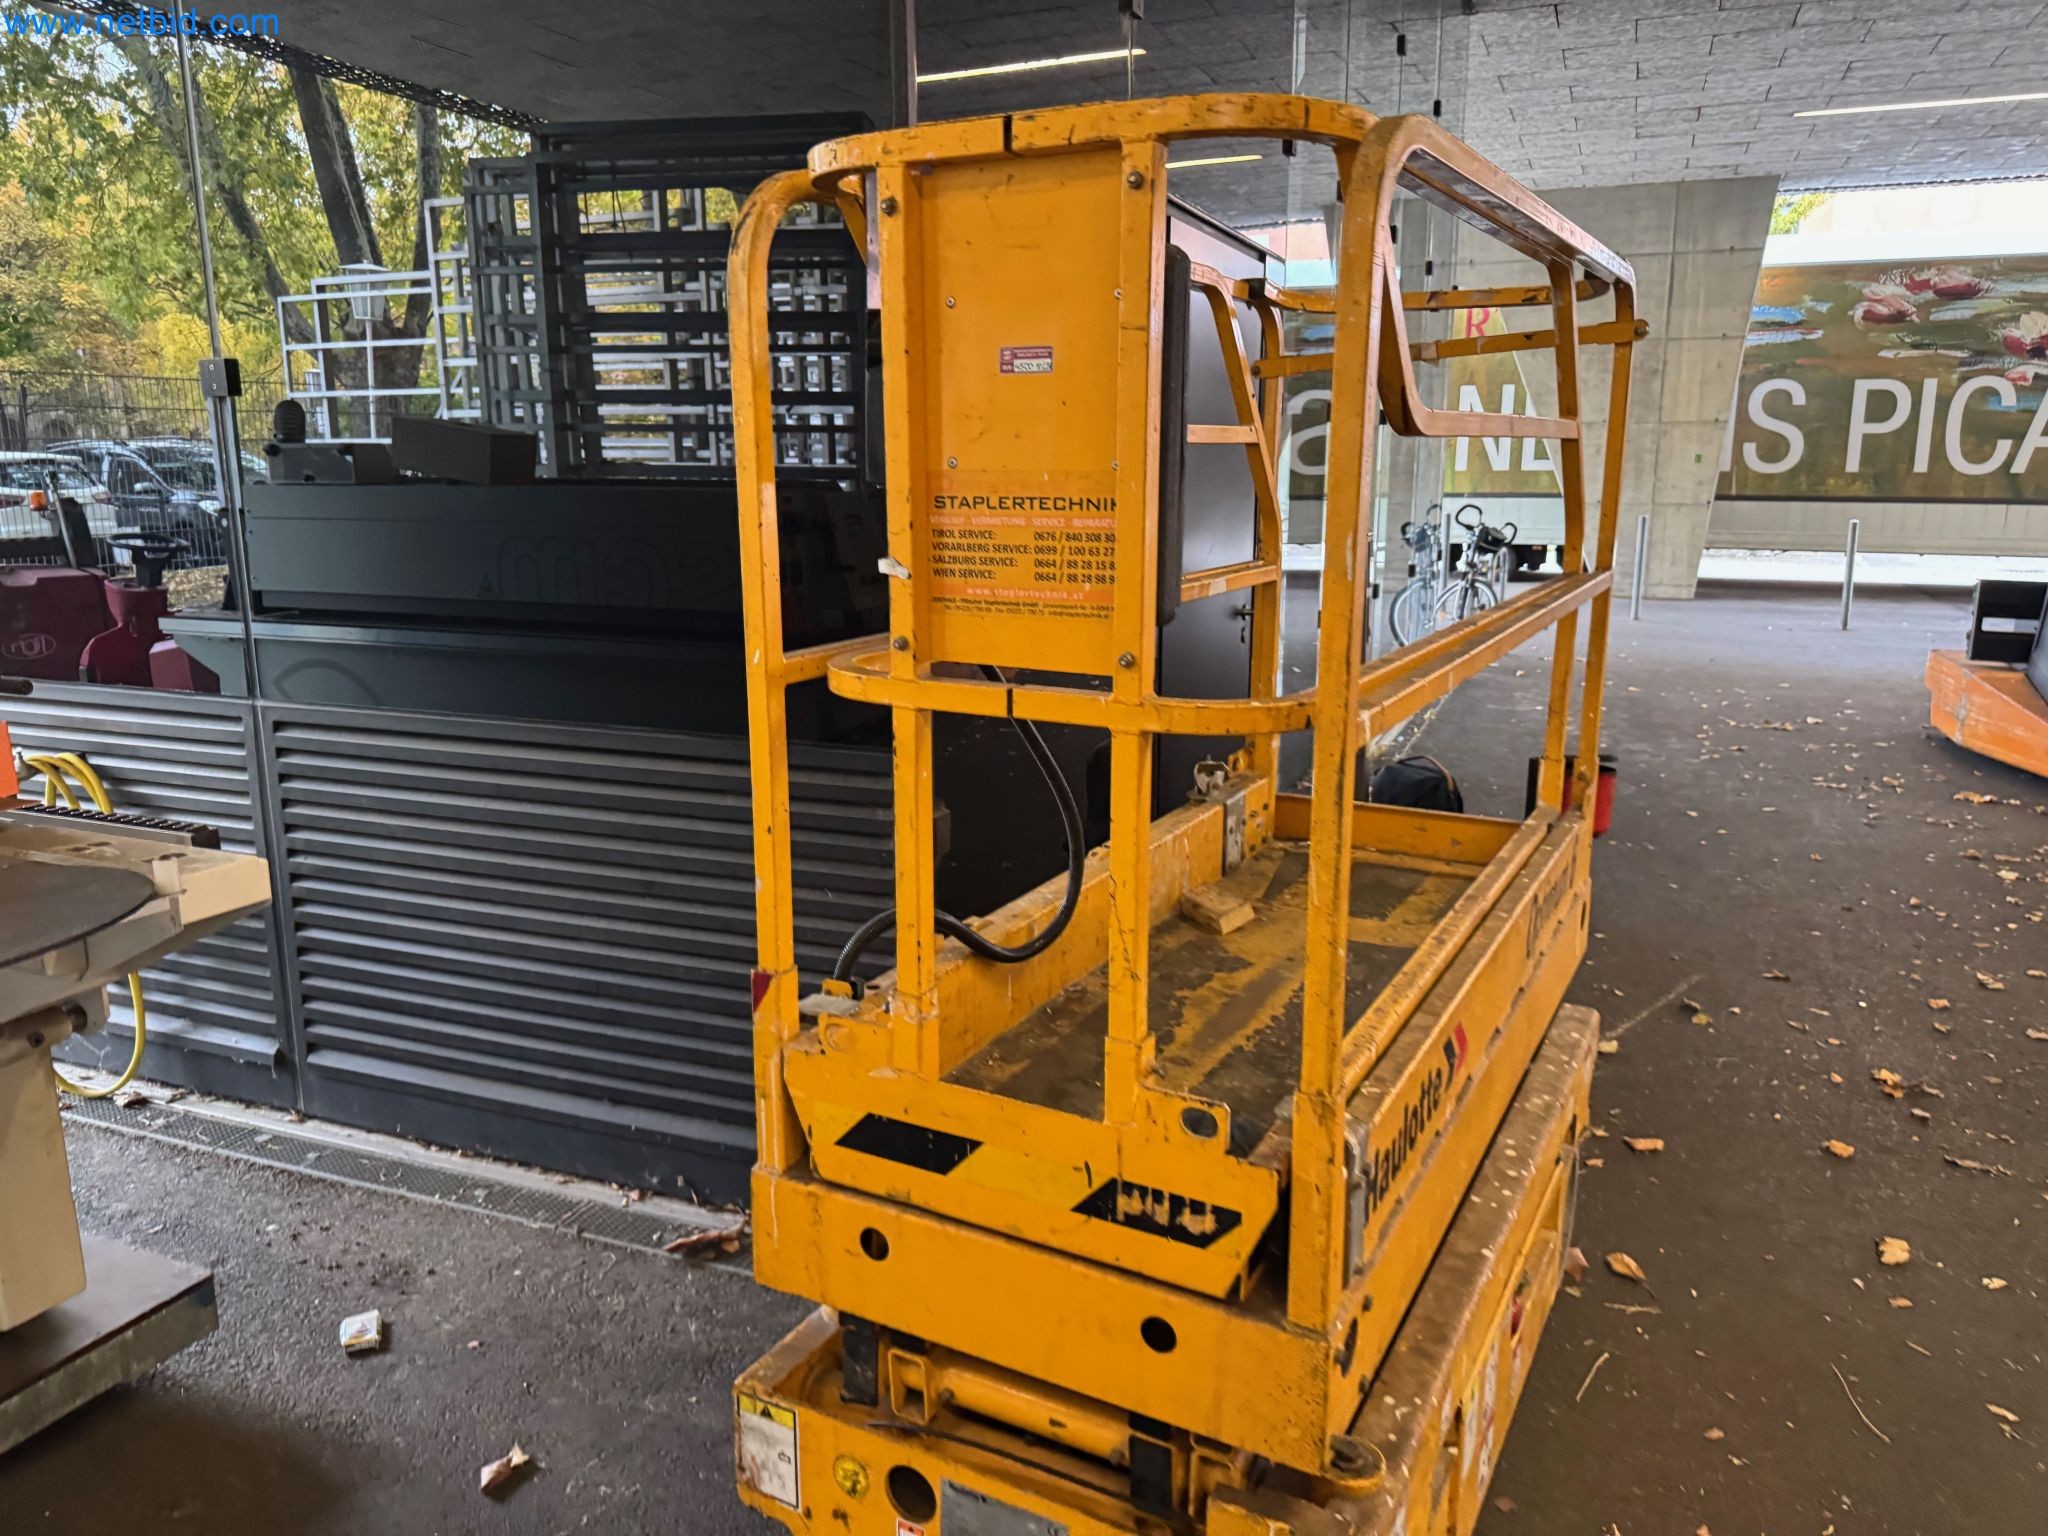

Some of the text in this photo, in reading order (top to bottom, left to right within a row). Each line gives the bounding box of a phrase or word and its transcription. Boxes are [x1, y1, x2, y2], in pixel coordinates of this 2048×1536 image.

[932, 528, 956, 539] TIROL
[959, 529, 997, 540] SERVICE:
[932, 541, 990, 553] VORARLBERG
[992, 543, 1033, 555] SERVICE:
[932, 554, 977, 566] SALZBURG
[978, 556, 1018, 568] SERVICE:
[932, 567, 956, 578] WIEN
[958, 568, 998, 580] SERVICE:
